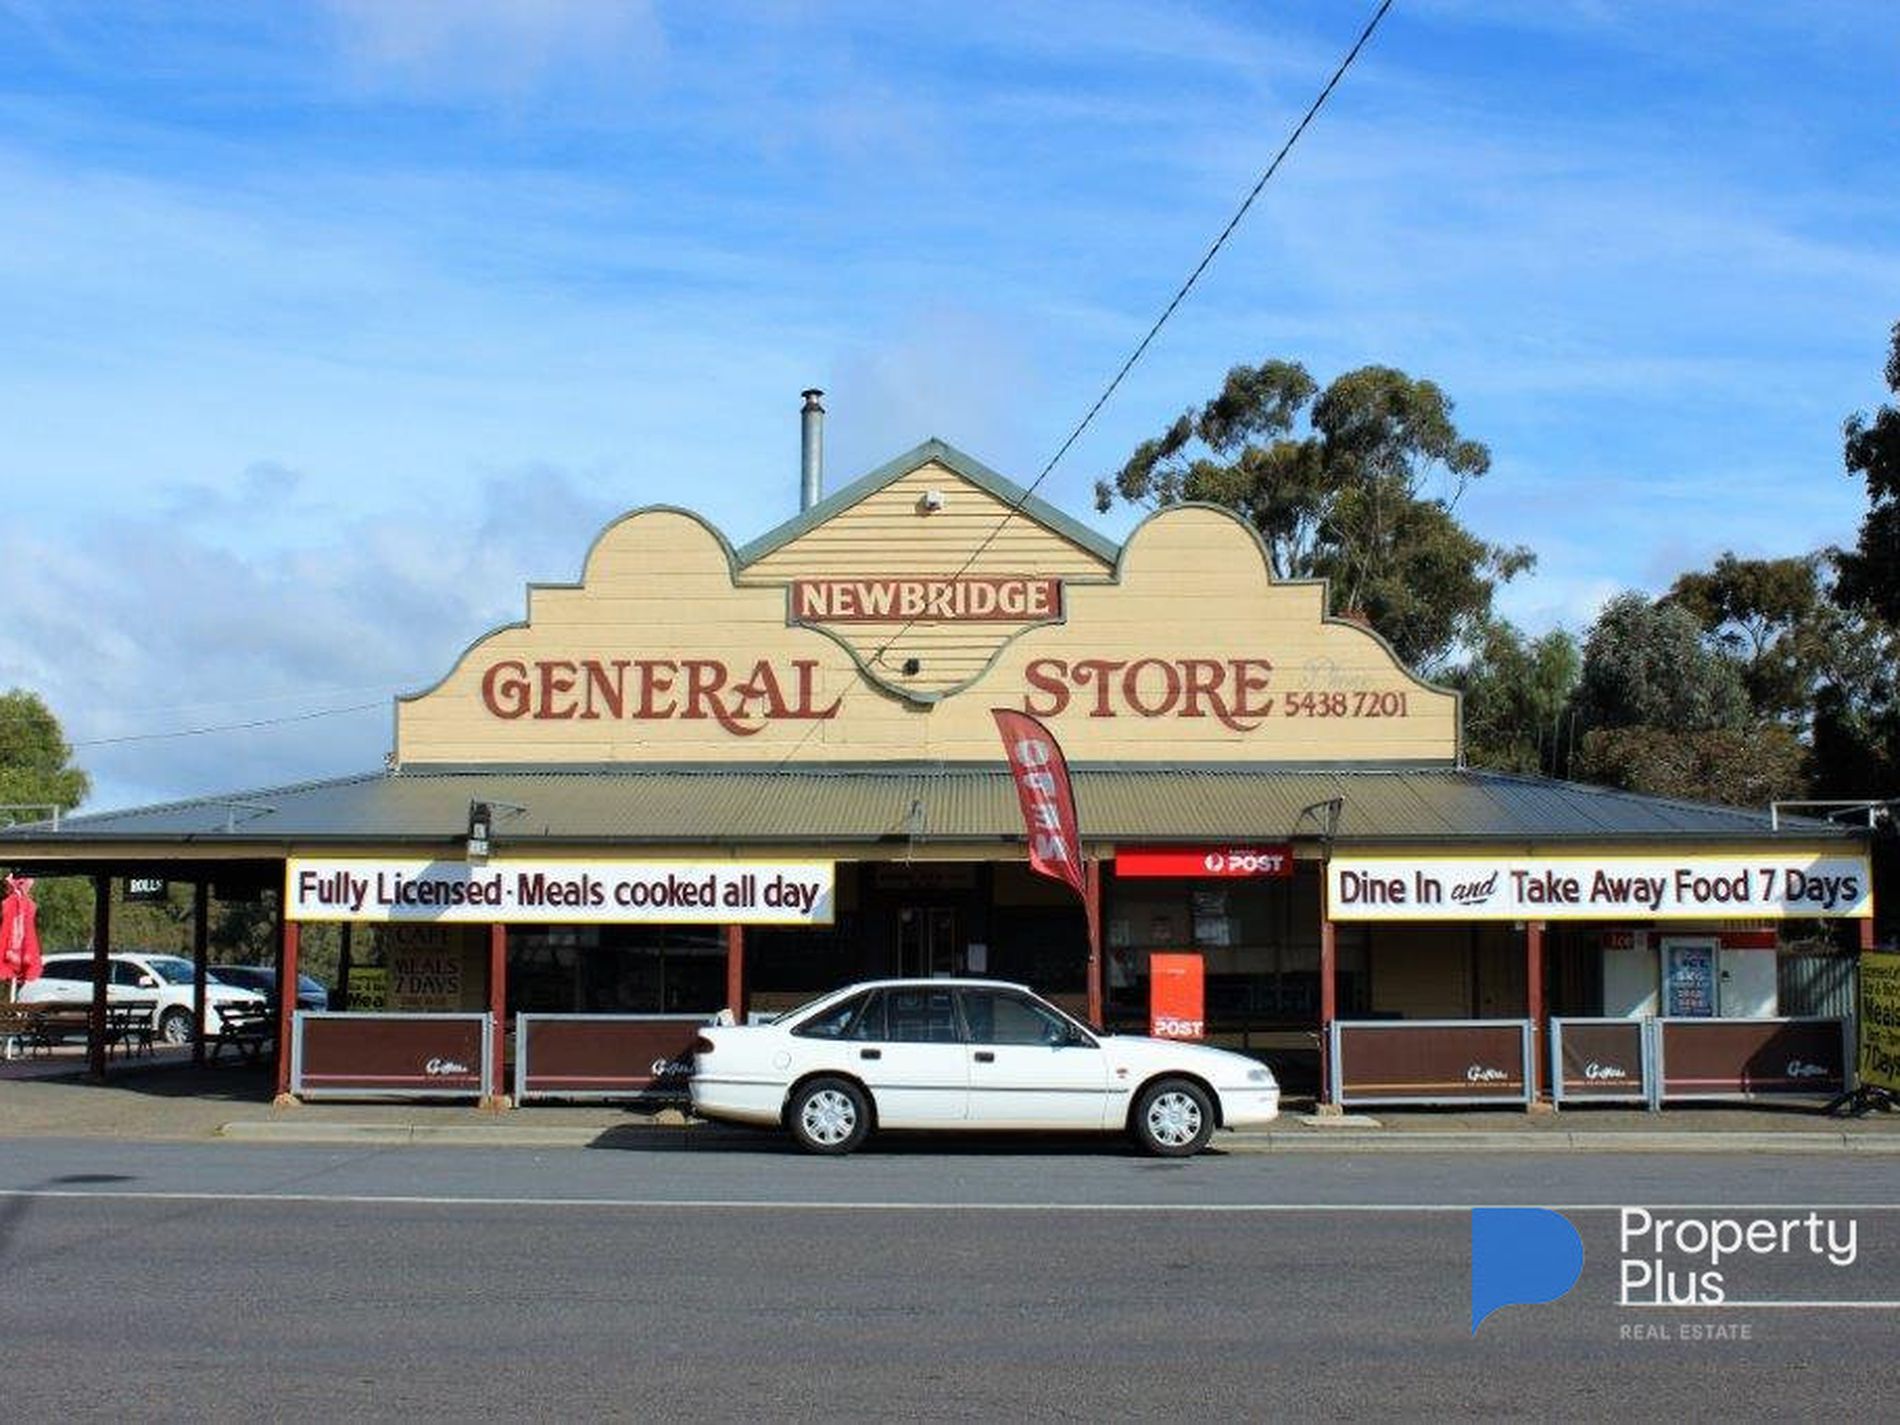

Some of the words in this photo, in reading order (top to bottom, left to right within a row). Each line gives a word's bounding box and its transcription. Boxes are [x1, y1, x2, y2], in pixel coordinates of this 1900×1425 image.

[802, 581, 1050, 617] NEWBRIDGE
[481, 659, 843, 736] GENERAL
[1024, 658, 1274, 732] STORE
[1285, 691, 1348, 718] 5438
[1352, 691, 1409, 718] 7201
[1228, 854, 1284, 872] POST
[299, 871, 368, 912] Fully
[377, 872, 503, 906] Licensed
[517, 873, 605, 907] Meals
[614, 874, 717, 908] cooked
[722, 874, 756, 908] all
[763, 875, 820, 915] day
[1340, 870, 1406, 904] Dine
[1415, 870, 1442, 904] In
[1450, 870, 1498, 906] and
[1510, 870, 1580, 904] Take
[1588, 870, 1667, 912] Away
[1675, 869, 1750, 903] Food
[1759, 869, 1777, 902] 7
[1785, 867, 1858, 910] Days
[1153, 1020, 1204, 1036] POST
